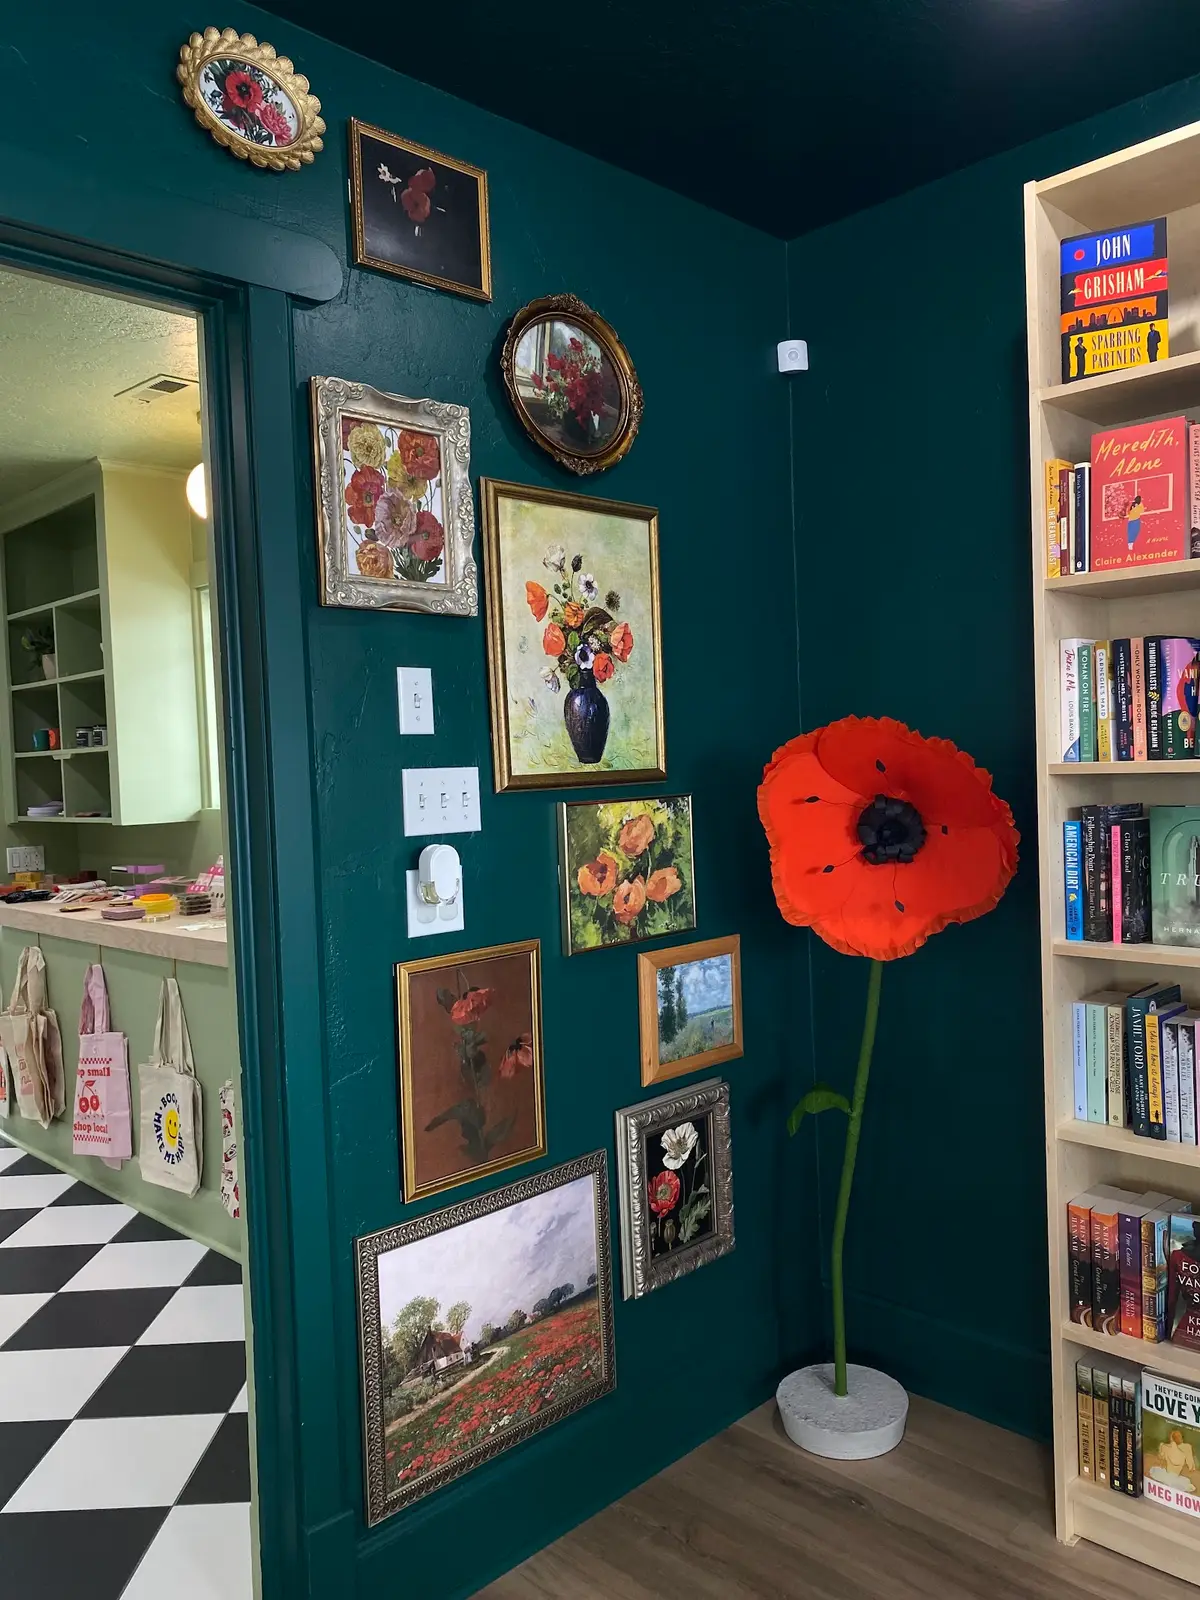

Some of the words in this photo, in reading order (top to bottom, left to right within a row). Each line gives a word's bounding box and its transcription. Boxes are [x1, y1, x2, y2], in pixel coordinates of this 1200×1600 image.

[1096, 234, 1131, 266] JOHN
[1084, 267, 1145, 300] GRISHAM
[1091, 327, 1141, 351] SPARRING
[1092, 347, 1142, 370] PARTNERS
[1109, 456, 1162, 478] Alone
[1048, 522, 1056, 550] READING
[1049, 551, 1057, 566] LIST
[1095, 557, 1122, 567] Claire
[1126, 549, 1178, 562] Alexander
[1064, 648, 1076, 671] Jackie
[1148, 646, 1157, 690] IMMORTALISTS
[1082, 682, 1088, 694] ON
[1065, 825, 1078, 870] AMERICAN
[1067, 870, 1078, 890] DIRT
[1132, 1006, 1142, 1038] JAMIE
[1134, 1041, 1144, 1069] FORD
[87, 1067, 110, 1076] small
[1150, 1078, 1159, 1098] always
[73, 1121, 91, 1133] shop
[93, 1123, 108, 1133] local
[154, 1112, 165, 1152] MAKE
[164, 1150, 175, 1164] ME
[1154, 1384, 1182, 1399] THEY'RE
[1146, 1389, 1187, 1420] LOVE
[1148, 1482, 1172, 1502] MEG
